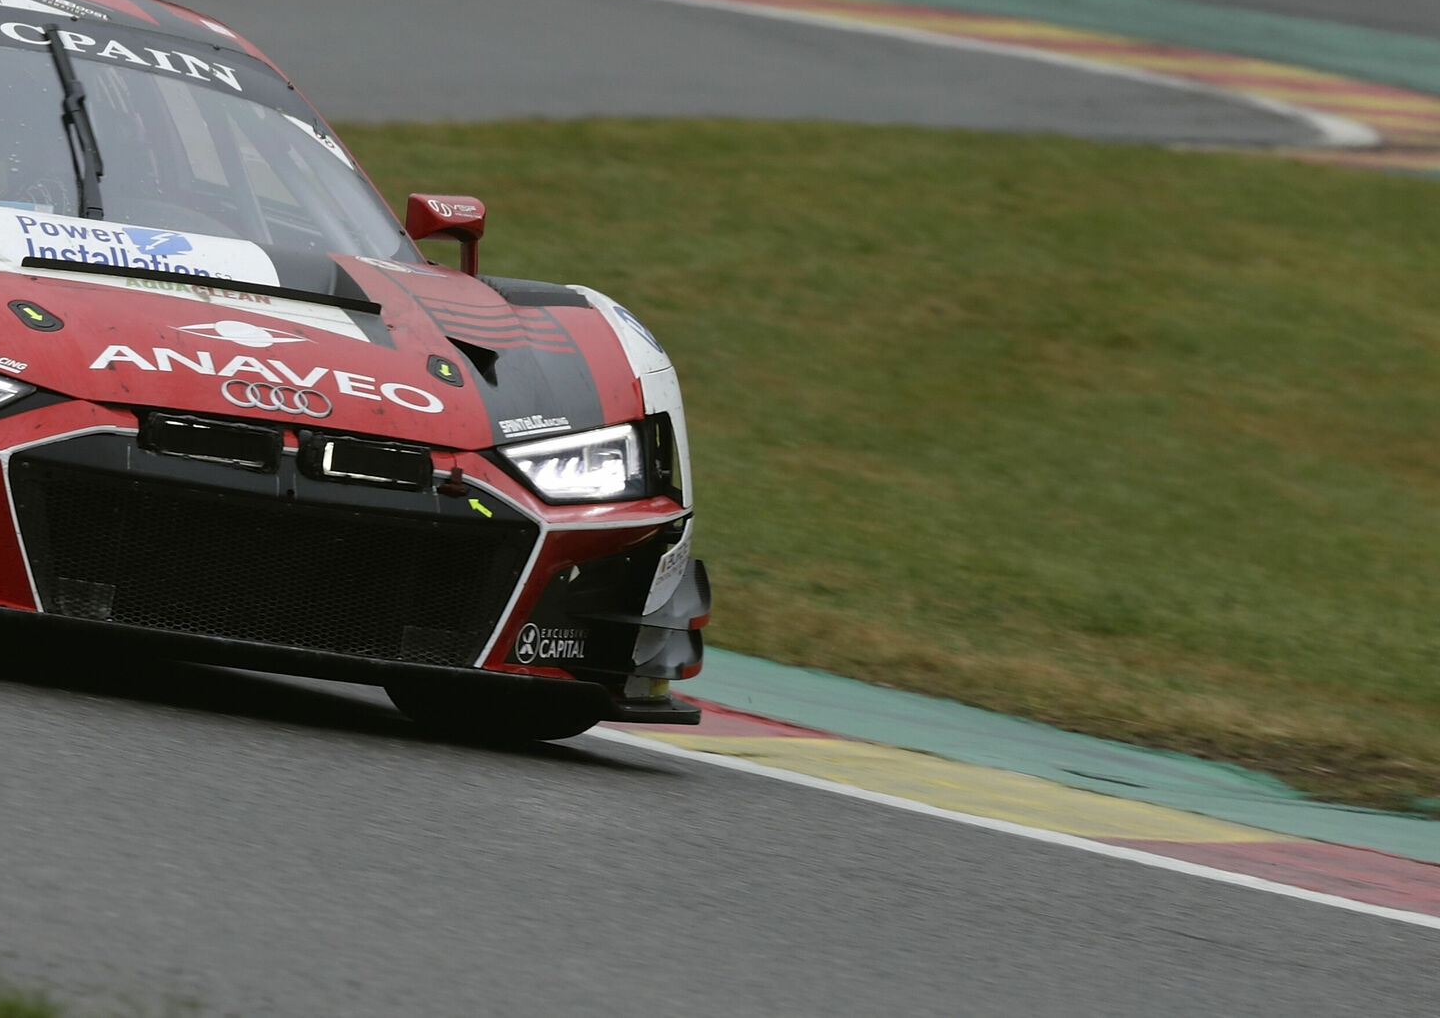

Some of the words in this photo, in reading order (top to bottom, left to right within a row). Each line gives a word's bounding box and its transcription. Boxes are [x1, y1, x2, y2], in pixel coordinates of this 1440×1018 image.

[16, 215, 124, 245] Power
[89, 344, 445, 414] ANAVEO
[538, 638, 586, 659] CAPITAL
